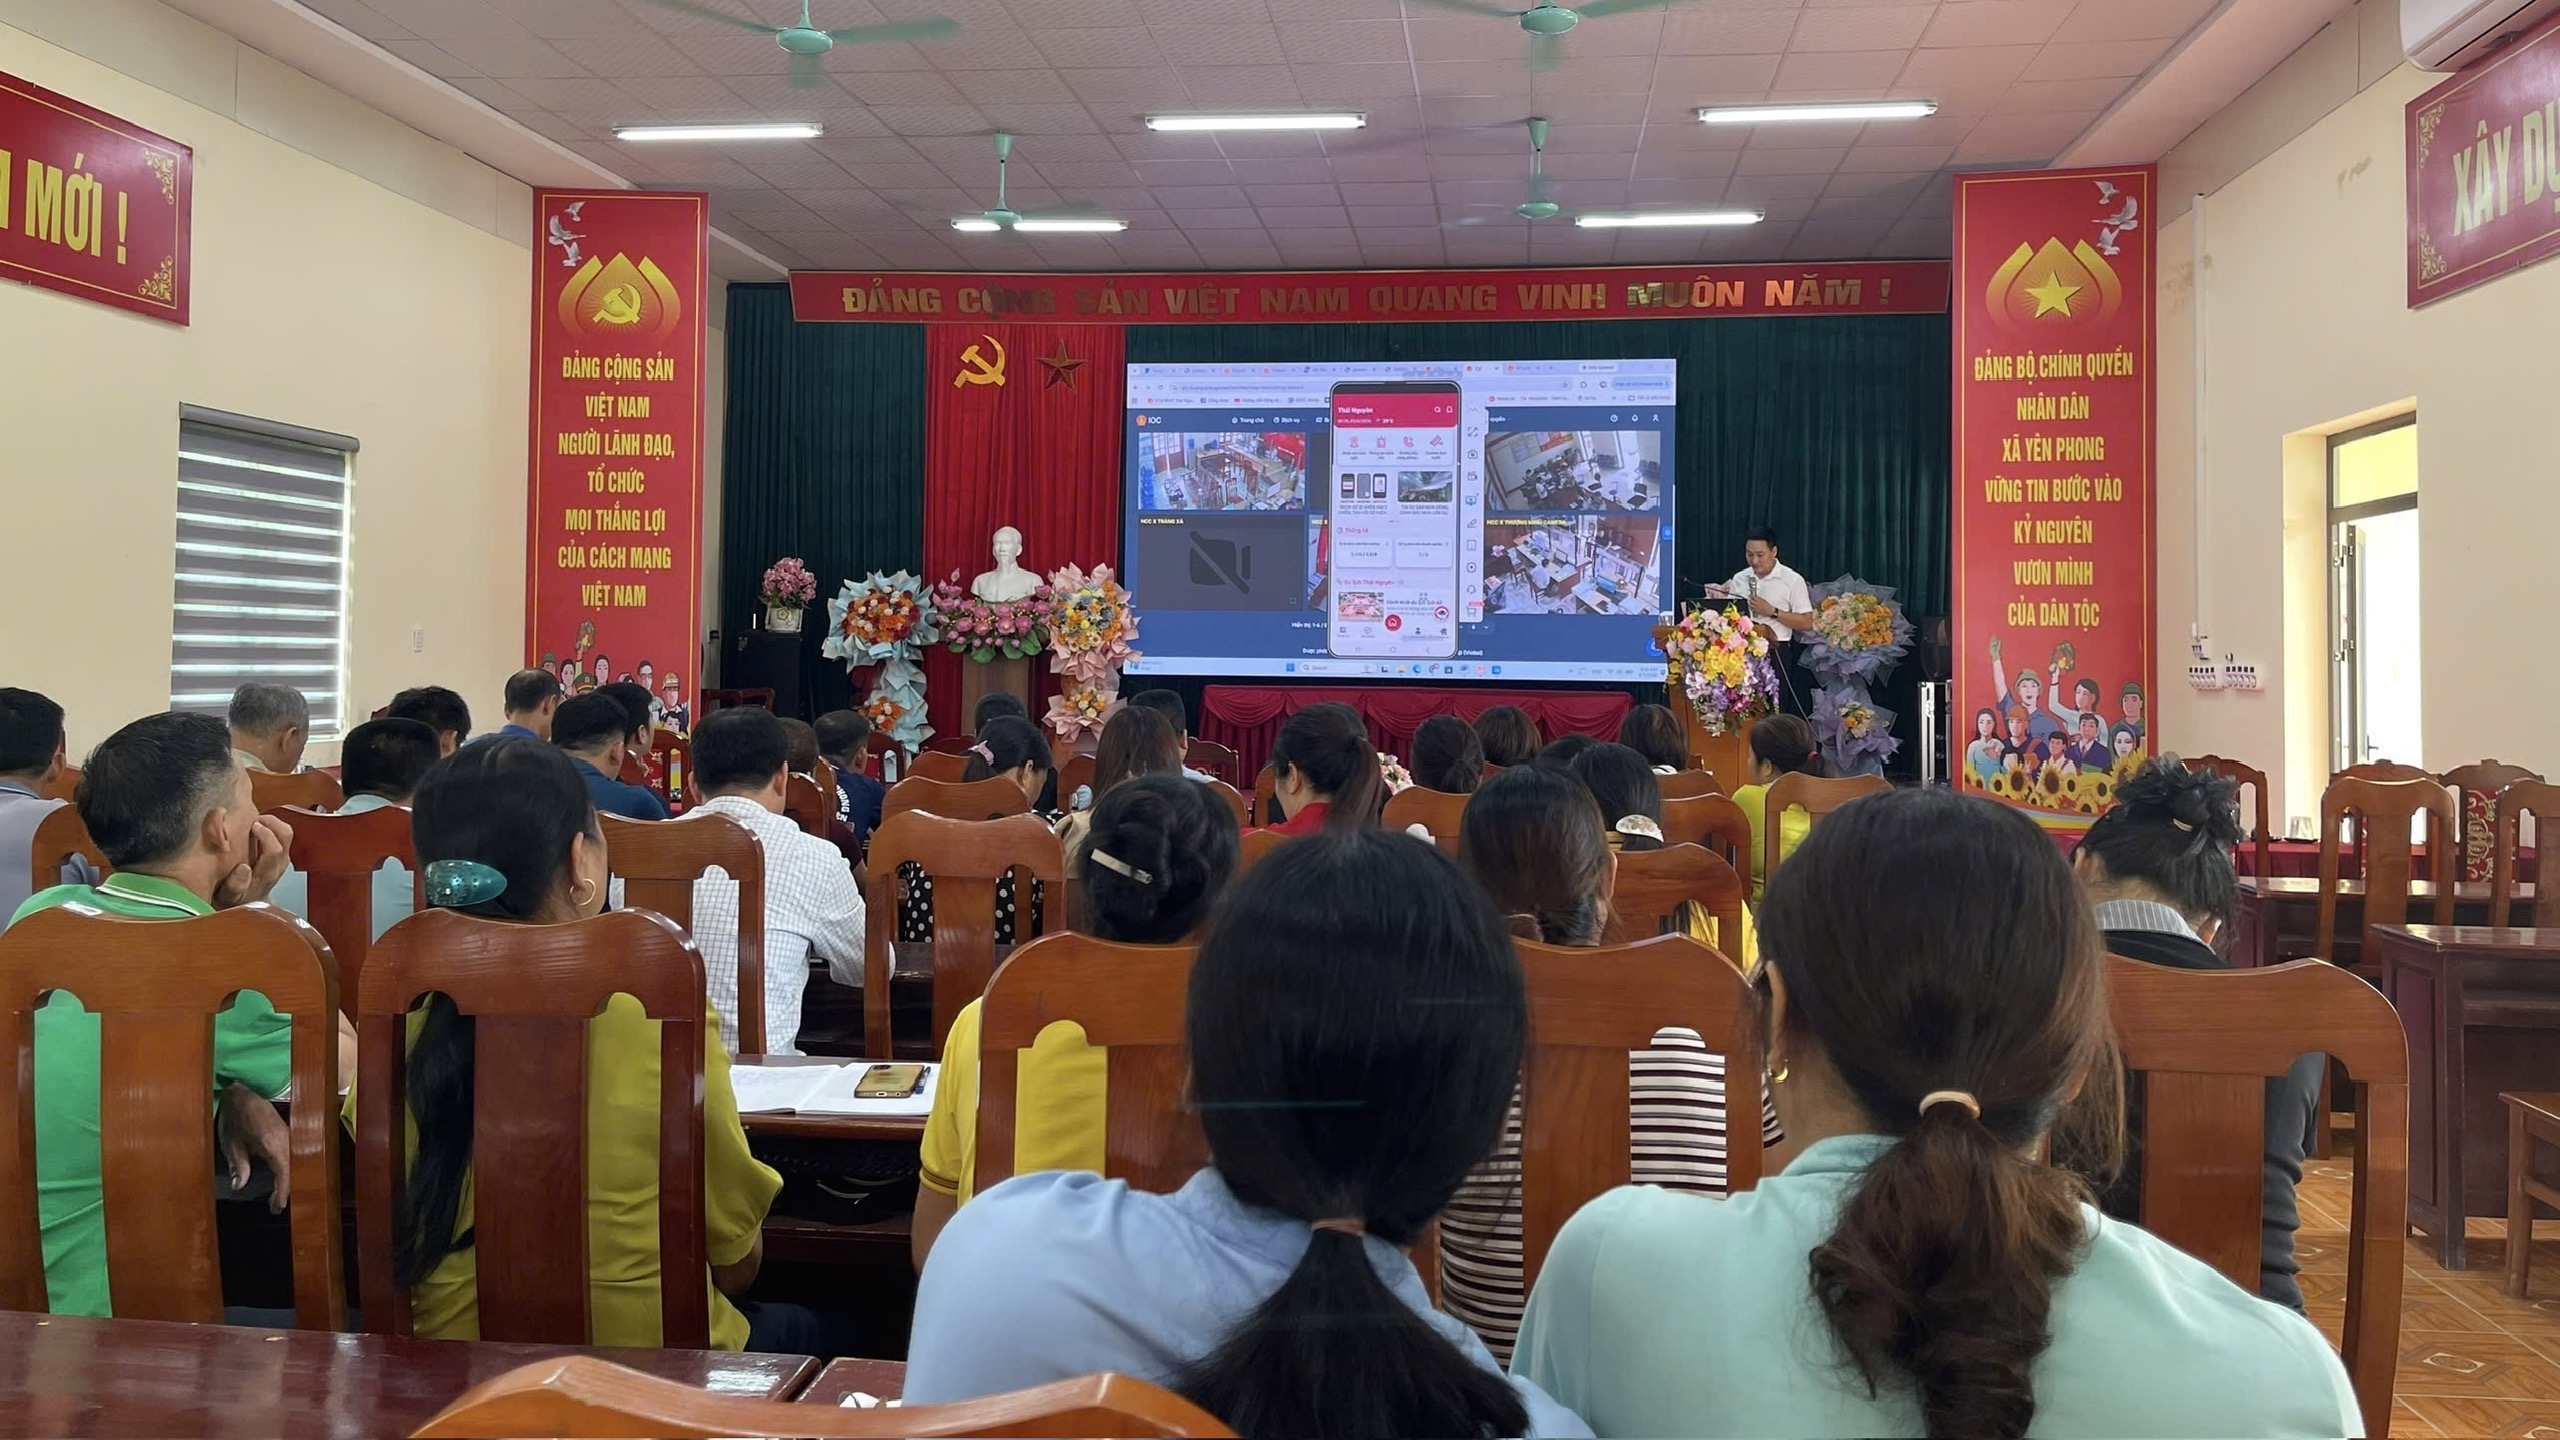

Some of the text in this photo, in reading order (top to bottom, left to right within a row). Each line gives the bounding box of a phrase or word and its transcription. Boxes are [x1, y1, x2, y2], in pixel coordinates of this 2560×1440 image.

[2453, 119, 2512, 236] XÂY
[25, 152, 103, 257] MỚI
[117, 191, 128, 265] !
[842, 273, 1890, 319] ĐẢNG CỘNG SẢN VIỆT NAM QUANG VINH MUÔN NĂM !
[563, 350, 674, 385] ĐẢNG CỘNG SẢN
[1975, 349, 2012, 381] ĐẢNG
[2039, 350, 2082, 378] CHÍNH
[2087, 345, 2133, 380] QUYỀN
[585, 391, 650, 422] VIỆT NAM
[2017, 391, 2089, 421] NHÂN DÂN
[559, 428, 675, 461] NGƯỜI LÃNH ĐẠO,
[2002, 433, 2104, 462] XÃ YÊN PHONG
[588, 463, 644, 493] TỔ CHỨC
[1985, 473, 2122, 503] VỮNG TIN BƯỚC VÀO
[565, 501, 666, 536] MỌI THẮNG LỢI
[2014, 512, 2093, 544] KỶ NGUYÊN
[558, 539, 671, 574] CỦA CÁCH MẠNG
[2014, 556, 2093, 585] VƯƠN MÌNH
[582, 580, 647, 611] VIỆT NAM
[2008, 595, 2100, 631] CỦA DÂN TỘC
